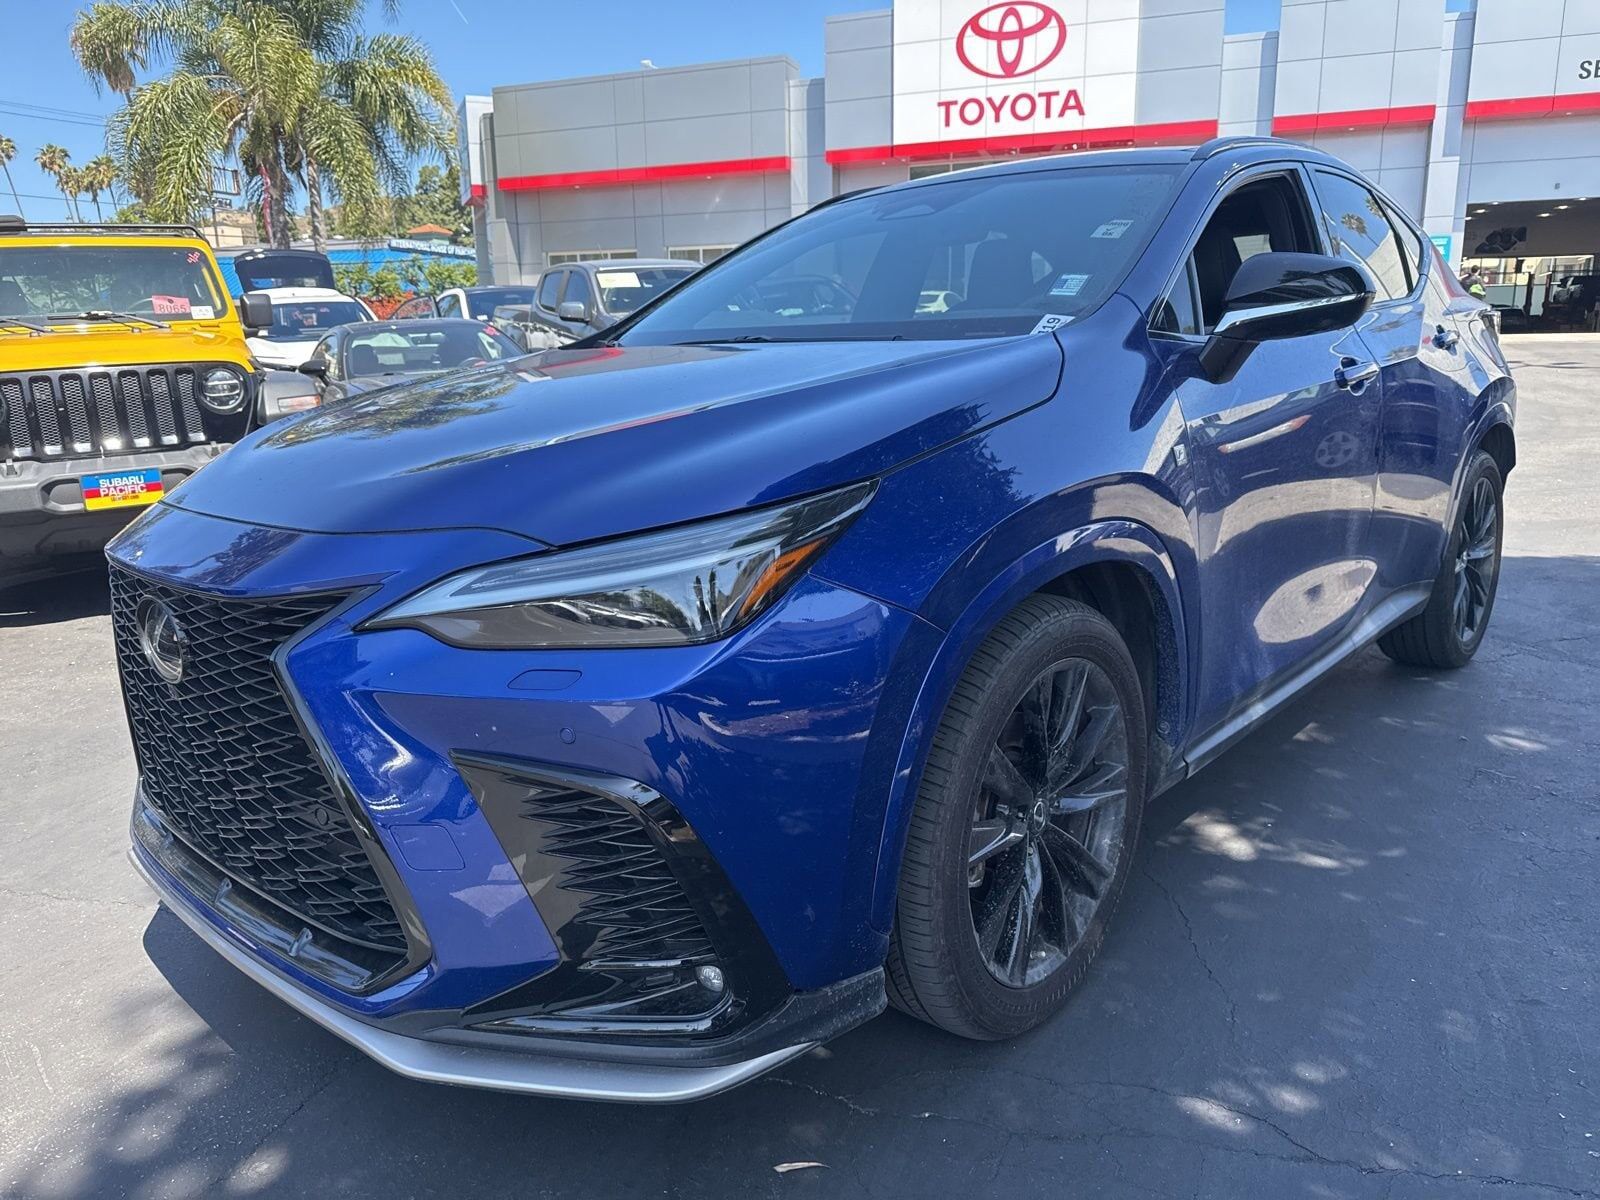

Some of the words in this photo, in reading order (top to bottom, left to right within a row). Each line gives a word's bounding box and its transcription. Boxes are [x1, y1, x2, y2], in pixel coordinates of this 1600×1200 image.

[937, 89, 1086, 128] TOYOTA
[158, 303, 187, 314] 8065
[99, 475, 144, 488] SUBARU
[99, 483, 147, 497] PACIFIC
